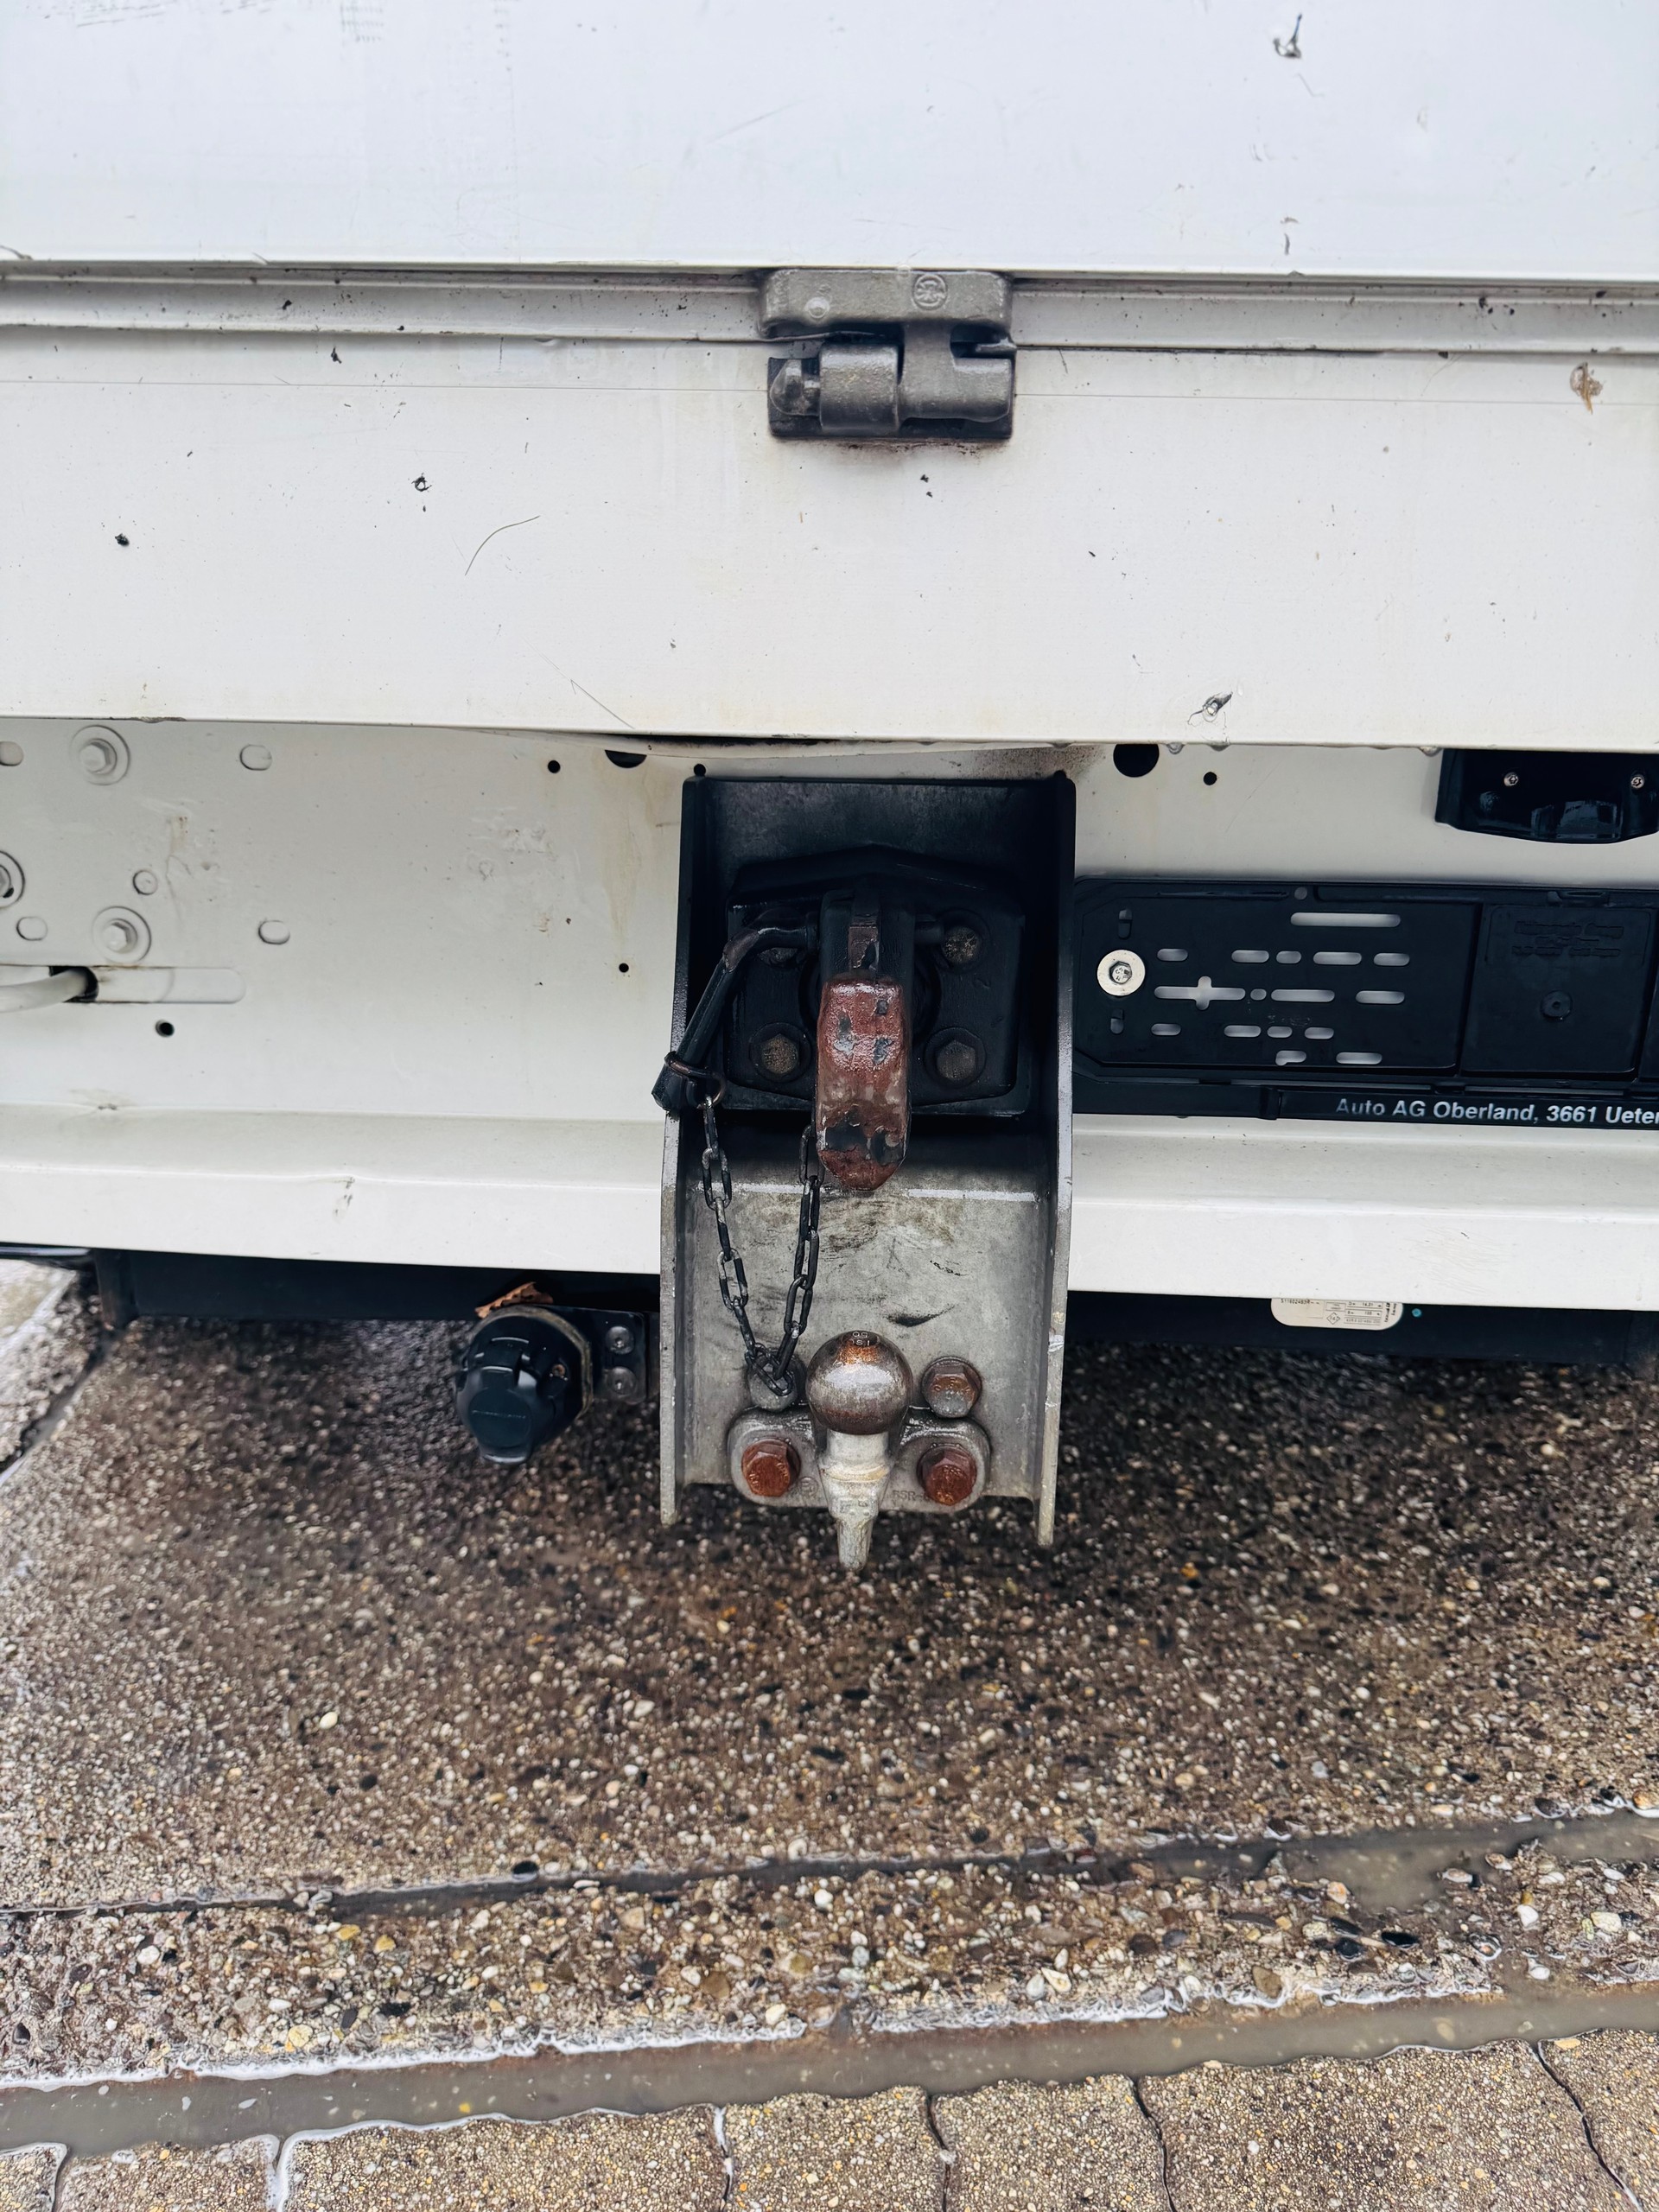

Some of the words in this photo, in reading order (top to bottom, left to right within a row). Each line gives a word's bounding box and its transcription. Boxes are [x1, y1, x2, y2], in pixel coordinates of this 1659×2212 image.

[1336, 1098, 1386, 1116] Auto
[1392, 1100, 1426, 1117] AG
[1433, 1101, 1539, 1124] Oberland,
[1546, 1105, 1597, 1122] 3661
